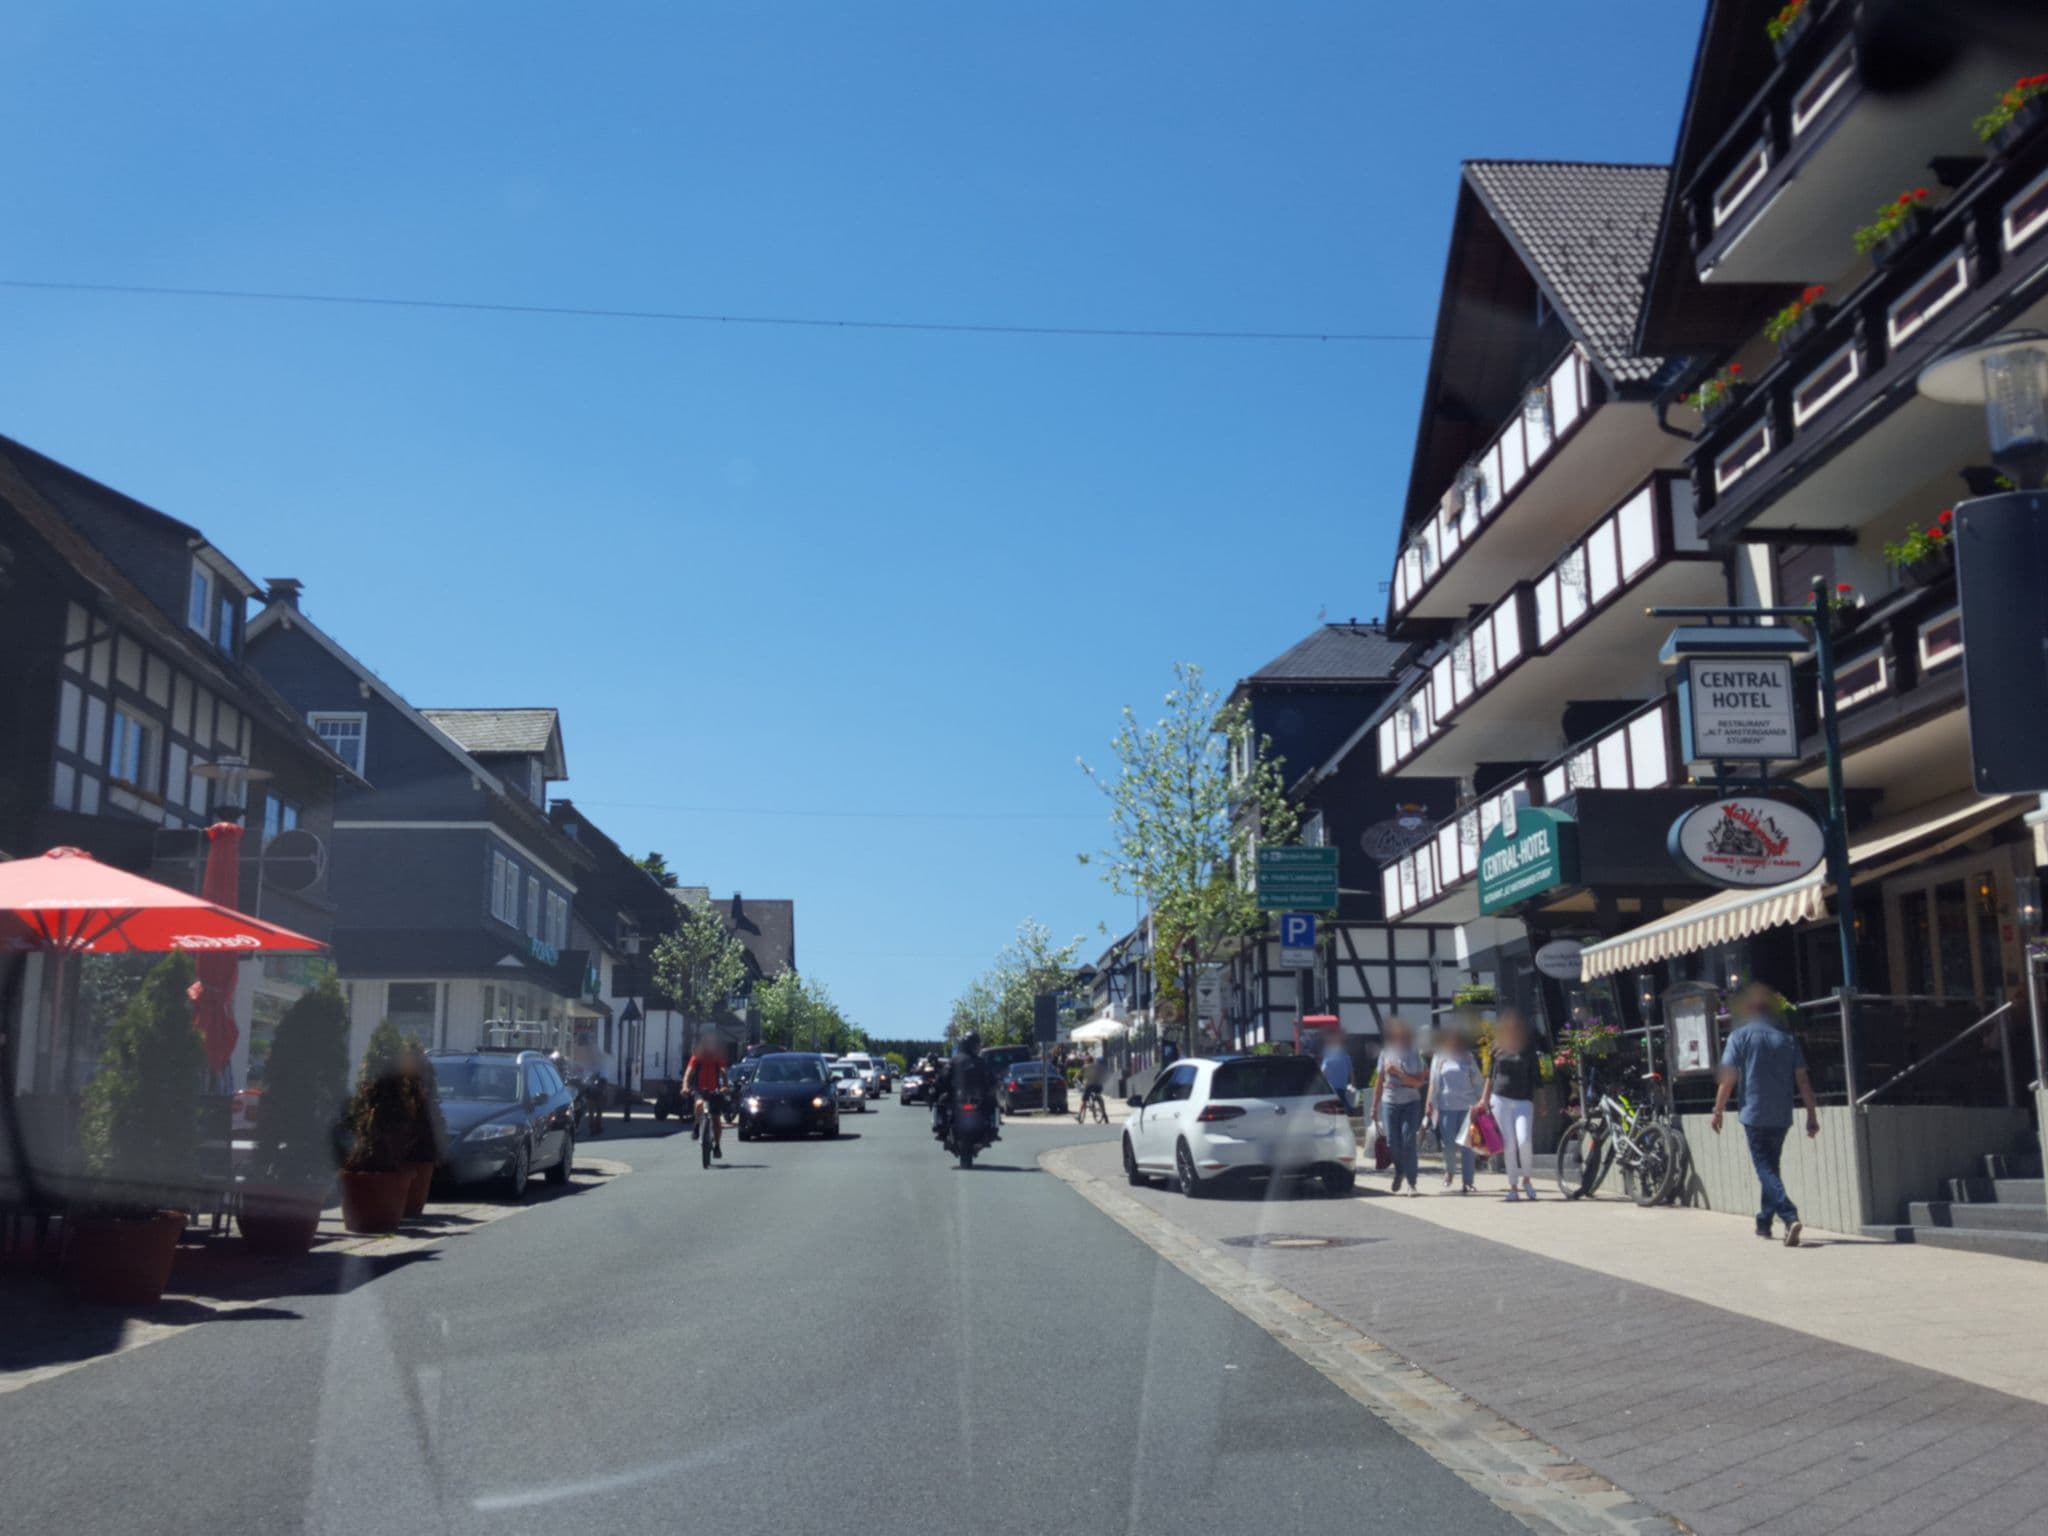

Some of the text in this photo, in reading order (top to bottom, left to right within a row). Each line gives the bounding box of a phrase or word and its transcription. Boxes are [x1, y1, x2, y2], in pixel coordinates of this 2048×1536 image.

[1700, 671, 1783, 689] CENTRAL
[1712, 691, 1772, 709] HOTEL
[1287, 917, 1307, 944] P
